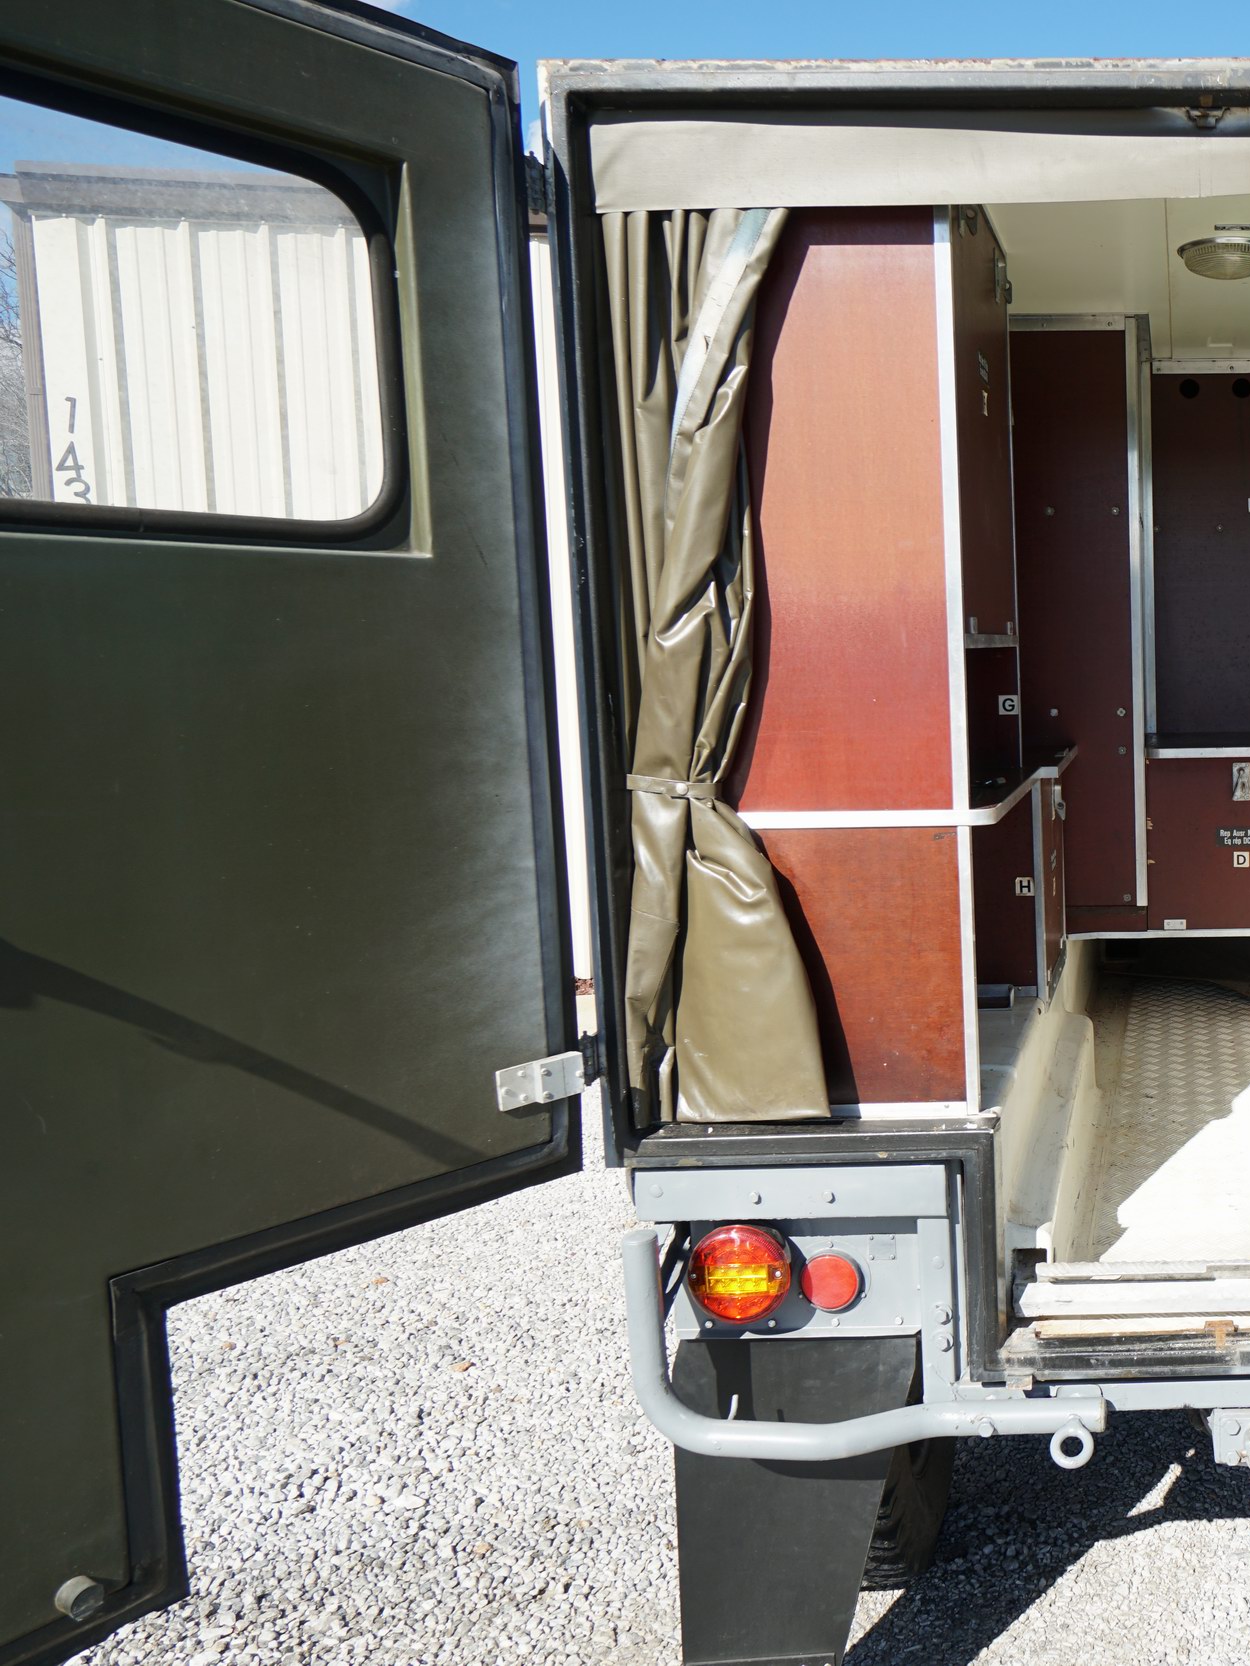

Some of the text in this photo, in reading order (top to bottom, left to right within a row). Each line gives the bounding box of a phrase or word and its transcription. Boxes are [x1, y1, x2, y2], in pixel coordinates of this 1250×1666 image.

[1002, 698, 1015, 712] G
[1220, 829, 1231, 838] Rep
[1224, 837, 1232, 845] Eq
[1236, 854, 1246, 865] D
[1020, 880, 1031, 893] H
